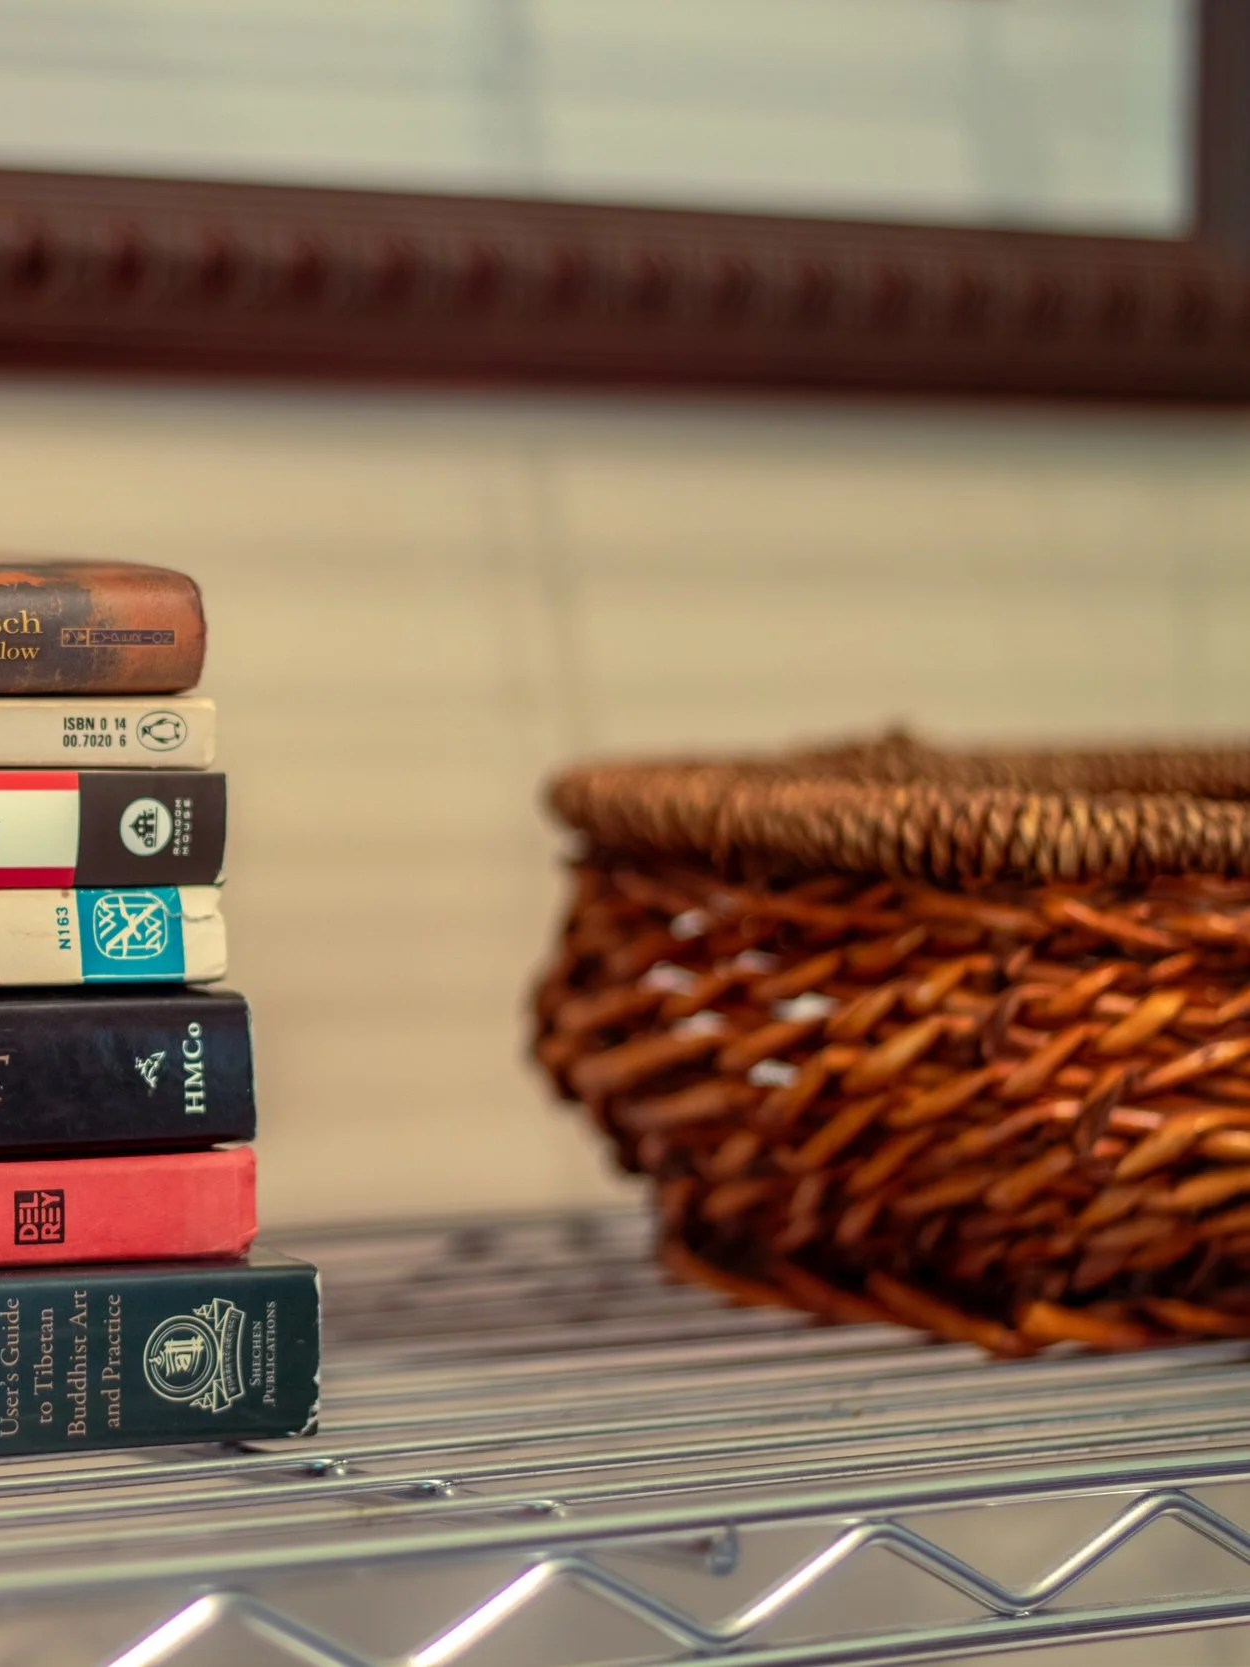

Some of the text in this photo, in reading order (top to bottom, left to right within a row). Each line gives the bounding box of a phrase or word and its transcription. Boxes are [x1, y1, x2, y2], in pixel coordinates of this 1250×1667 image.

[62, 734, 126, 747] 00.7020 6
[63, 717, 126, 730] ISBN 0 14
[172, 798, 182, 856] RANDOM
[182, 799, 192, 856] HOUSE
[56, 906, 71, 950] N163
[182, 1021, 206, 1115] HMCo
[19, 1192, 39, 1241] DEL
[40, 1192, 61, 1241] REY
[0, 1298, 20, 1438] User's Guide
[33, 1308, 54, 1424] to Tibetan
[67, 1290, 87, 1436] Buddhist Art
[100, 1294, 121, 1428] and Practice
[250, 1321, 262, 1387] SHECHEN
[263, 1301, 276, 1404] PUBLICATIONS
